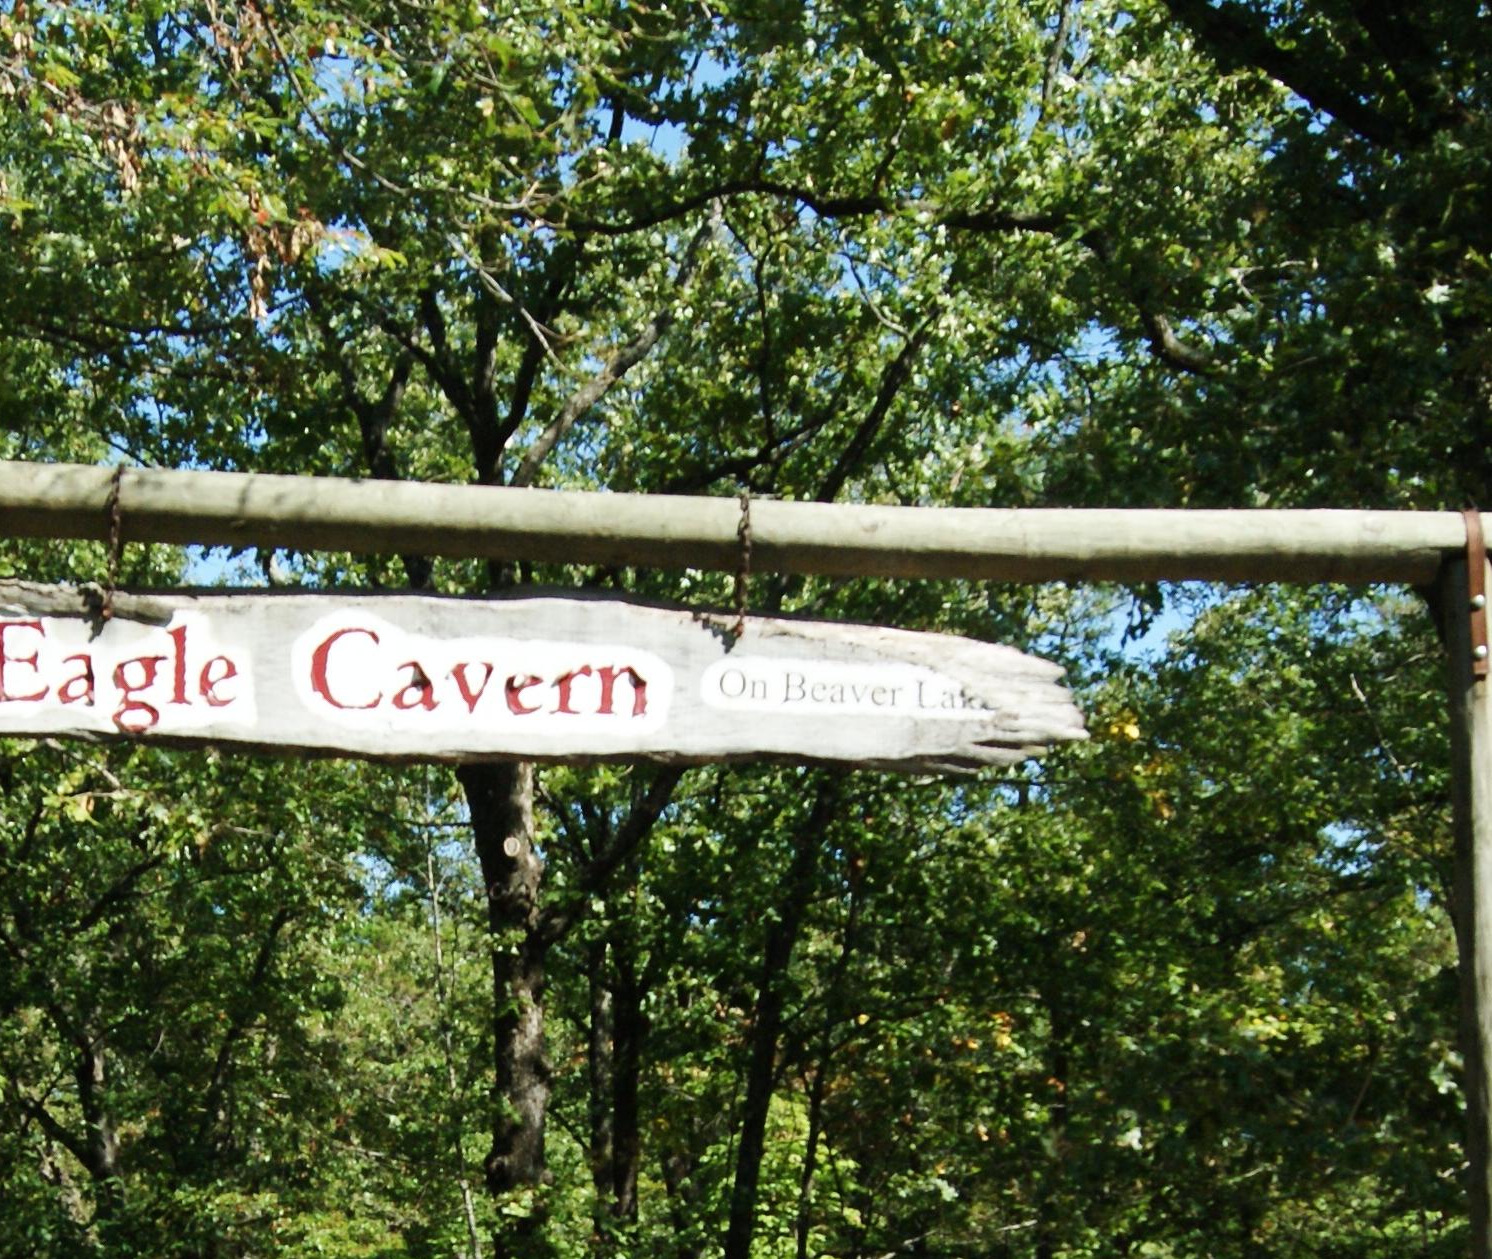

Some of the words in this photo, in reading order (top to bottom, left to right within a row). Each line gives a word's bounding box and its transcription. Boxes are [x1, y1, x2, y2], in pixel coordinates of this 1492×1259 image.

[311, 627, 647, 718] Cavern
[719, 668, 767, 699] On
[782, 671, 902, 707] Beaver
